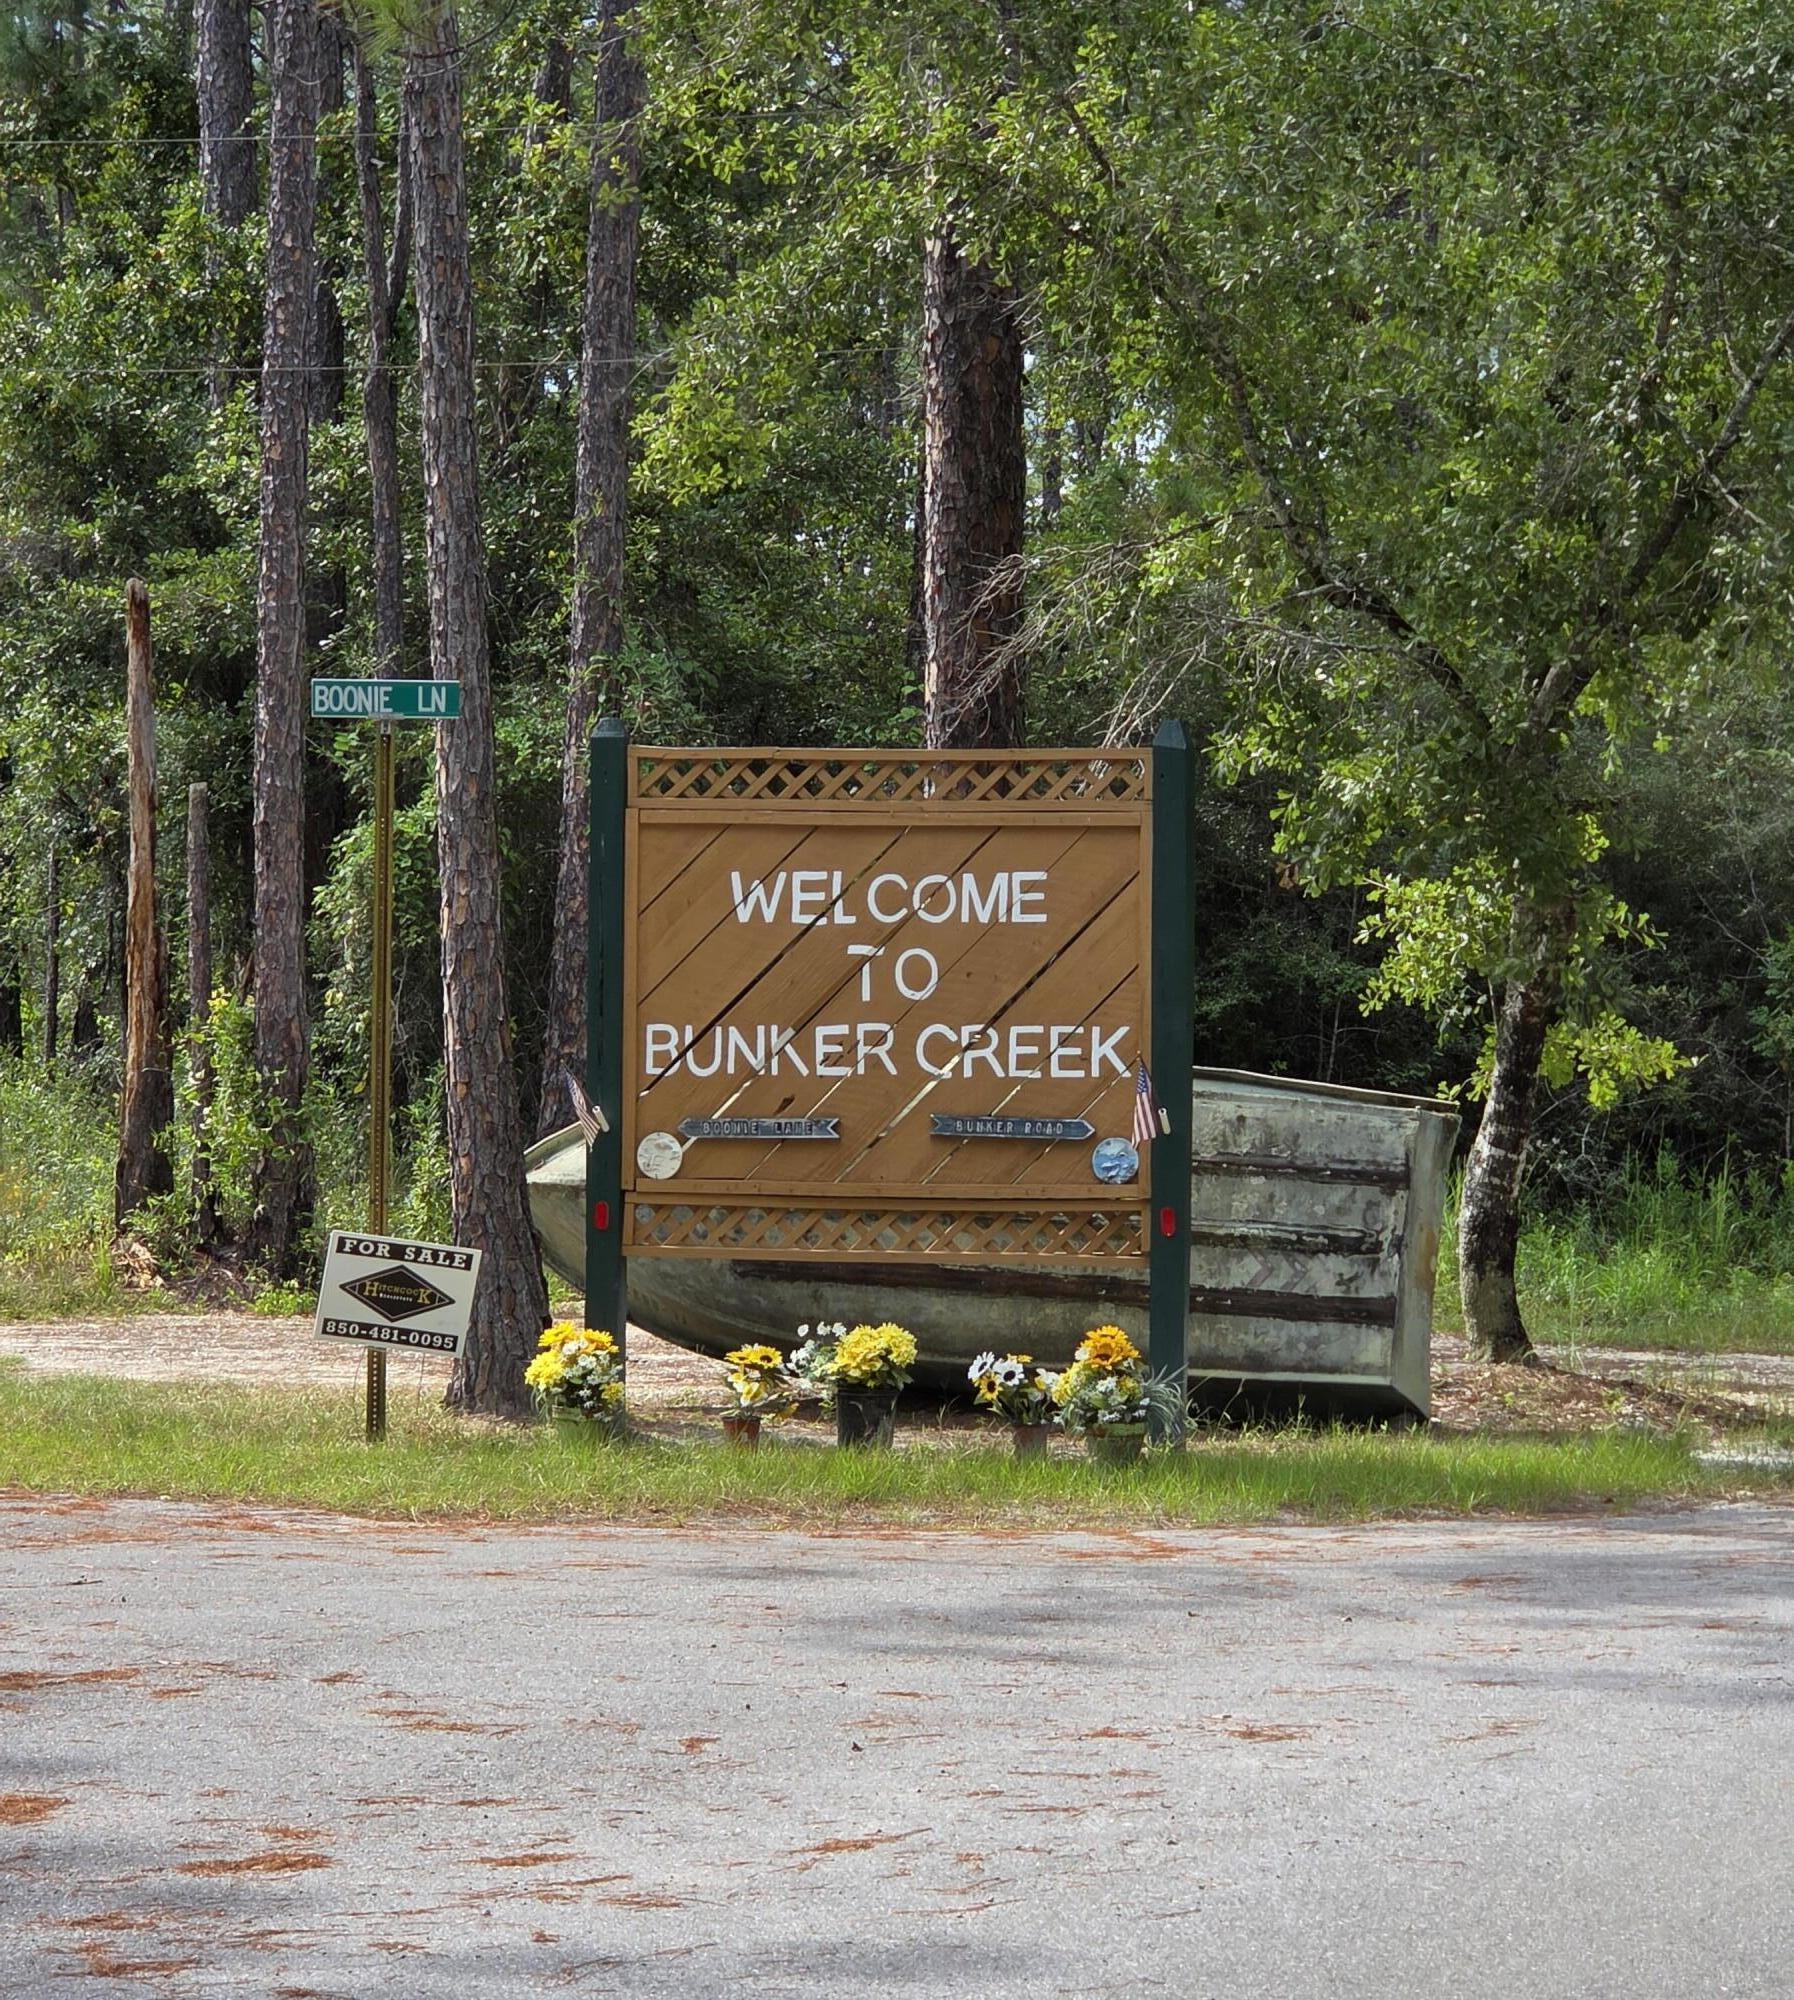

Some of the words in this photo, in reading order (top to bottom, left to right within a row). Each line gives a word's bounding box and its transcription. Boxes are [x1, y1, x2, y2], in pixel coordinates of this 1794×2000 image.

[314, 685, 393, 713] BOONIE
[418, 685, 446, 713] LN
[731, 870, 1048, 926] WELCOME
[847, 944, 939, 1002] TO
[645, 1023, 898, 1077] BUNKER
[915, 1023, 1133, 1079] CREEK
[703, 1121, 759, 1135] BOONIE
[956, 1119, 1014, 1133] BUNKER
[1024, 1121, 1064, 1135] ROAD
[343, 1238, 391, 1258] FOR
[404, 1246, 467, 1268] SALE
[325, 1320, 455, 1349] 850-481-0095
